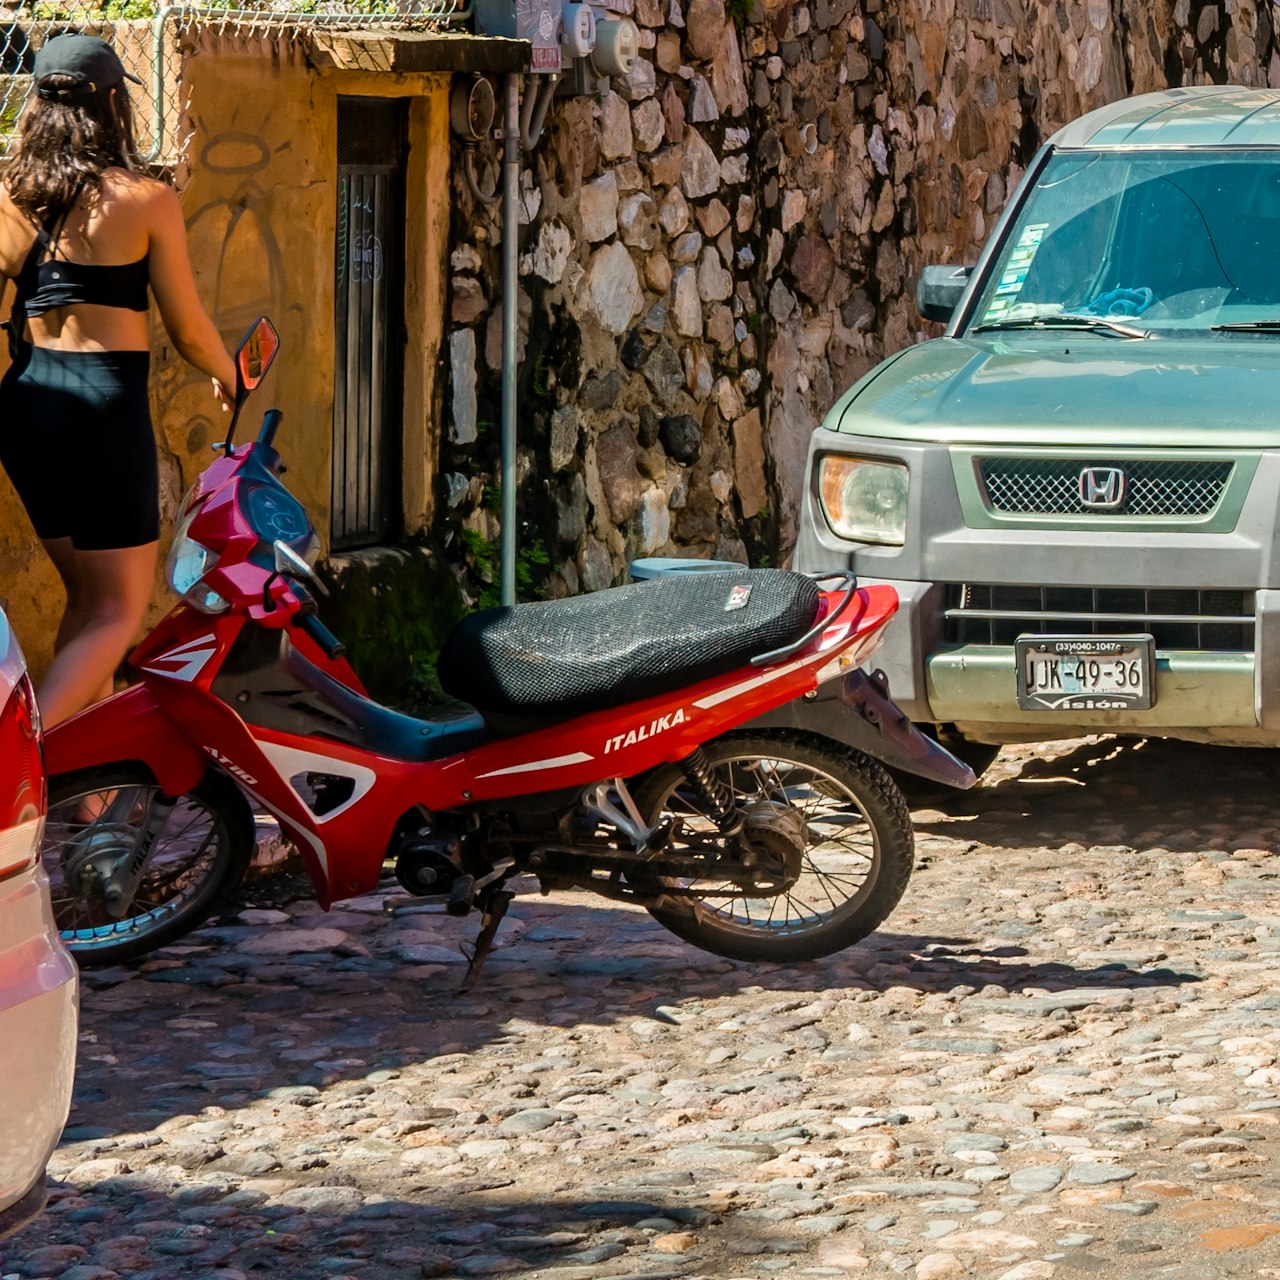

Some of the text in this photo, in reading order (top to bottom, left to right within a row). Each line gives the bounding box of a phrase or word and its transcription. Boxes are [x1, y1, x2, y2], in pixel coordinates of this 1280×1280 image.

[1055, 642, 1116, 652] (33)4040-1047
[604, 708, 686, 755] ITALIKA
[202, 745, 259, 785] AT110
